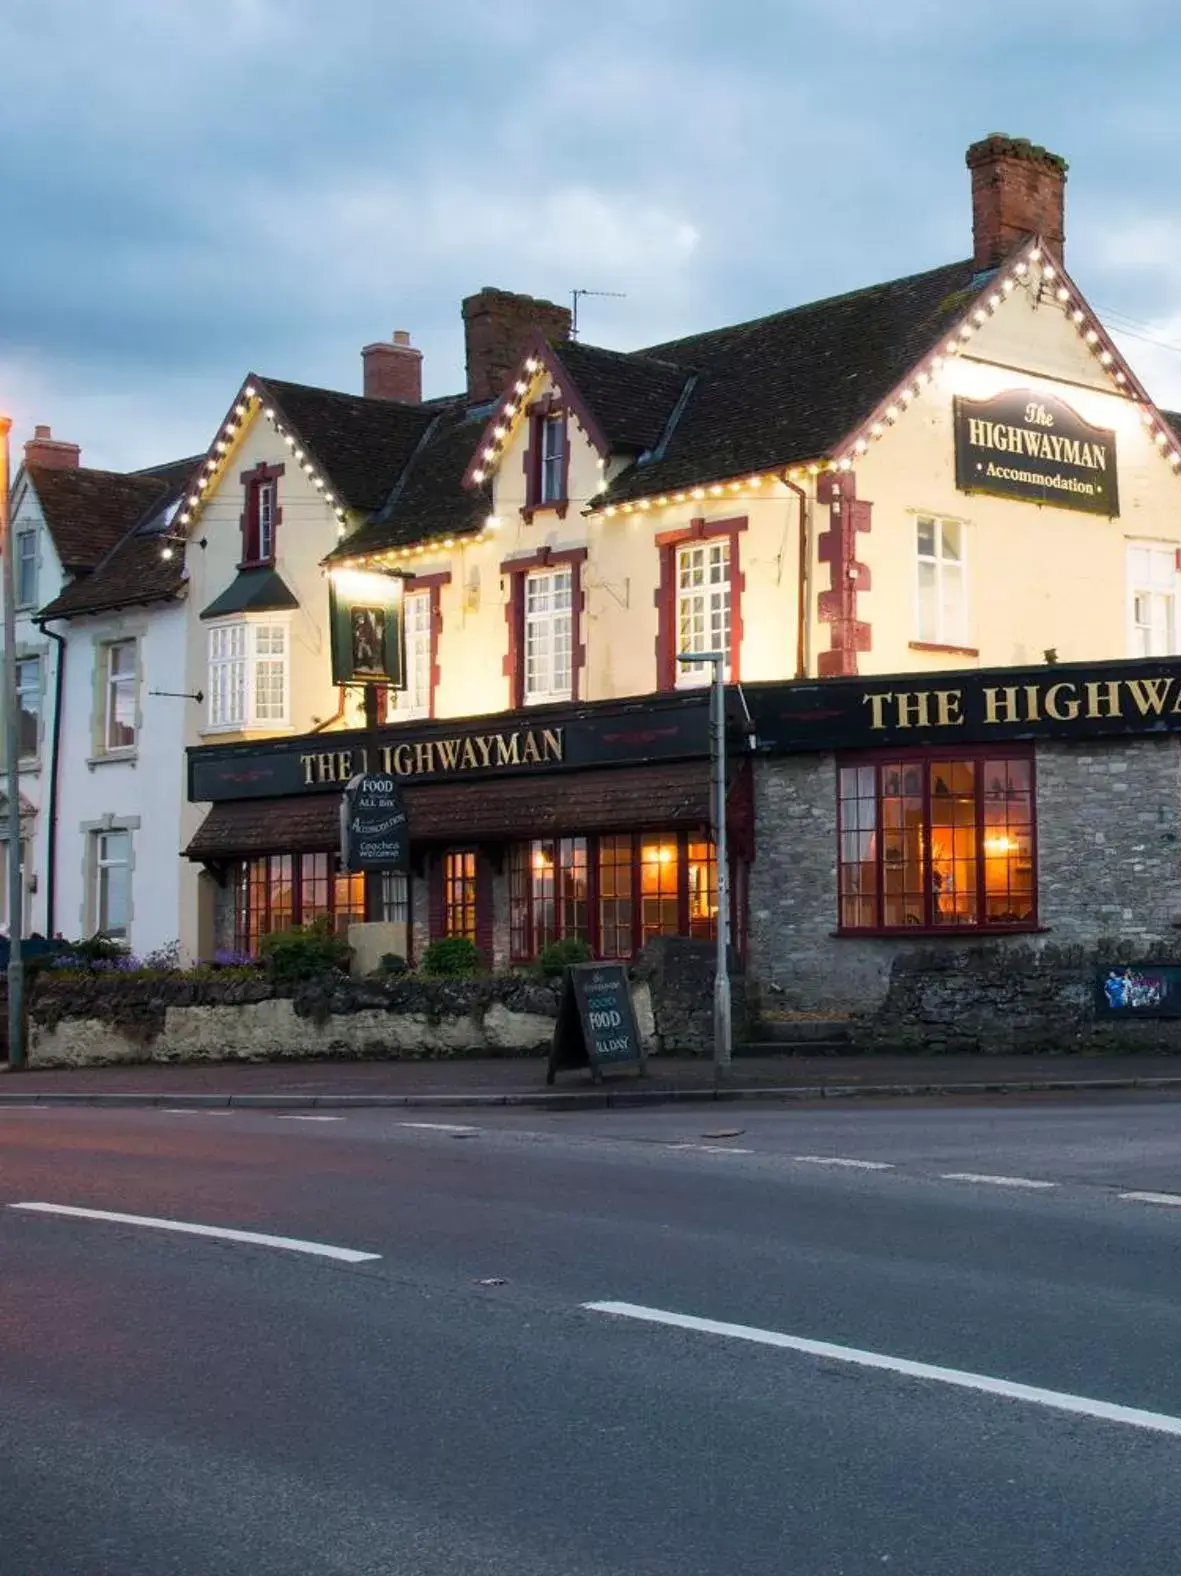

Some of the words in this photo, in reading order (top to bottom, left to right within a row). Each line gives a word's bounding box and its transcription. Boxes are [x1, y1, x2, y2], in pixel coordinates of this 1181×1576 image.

[1024, 402, 1054, 427] The
[968, 418, 1106, 471] HIGHWAYMAN
[986, 461, 1094, 495] Accommodation
[862, 690, 965, 730] THE
[300, 751, 353, 784] THE
[362, 727, 564, 775] IGHWAYMAN
[362, 780, 393, 793] FOOD
[360, 799, 376, 807] ALL
[589, 1011, 621, 1030] FOOD
[610, 1036, 630, 1051] DAY
